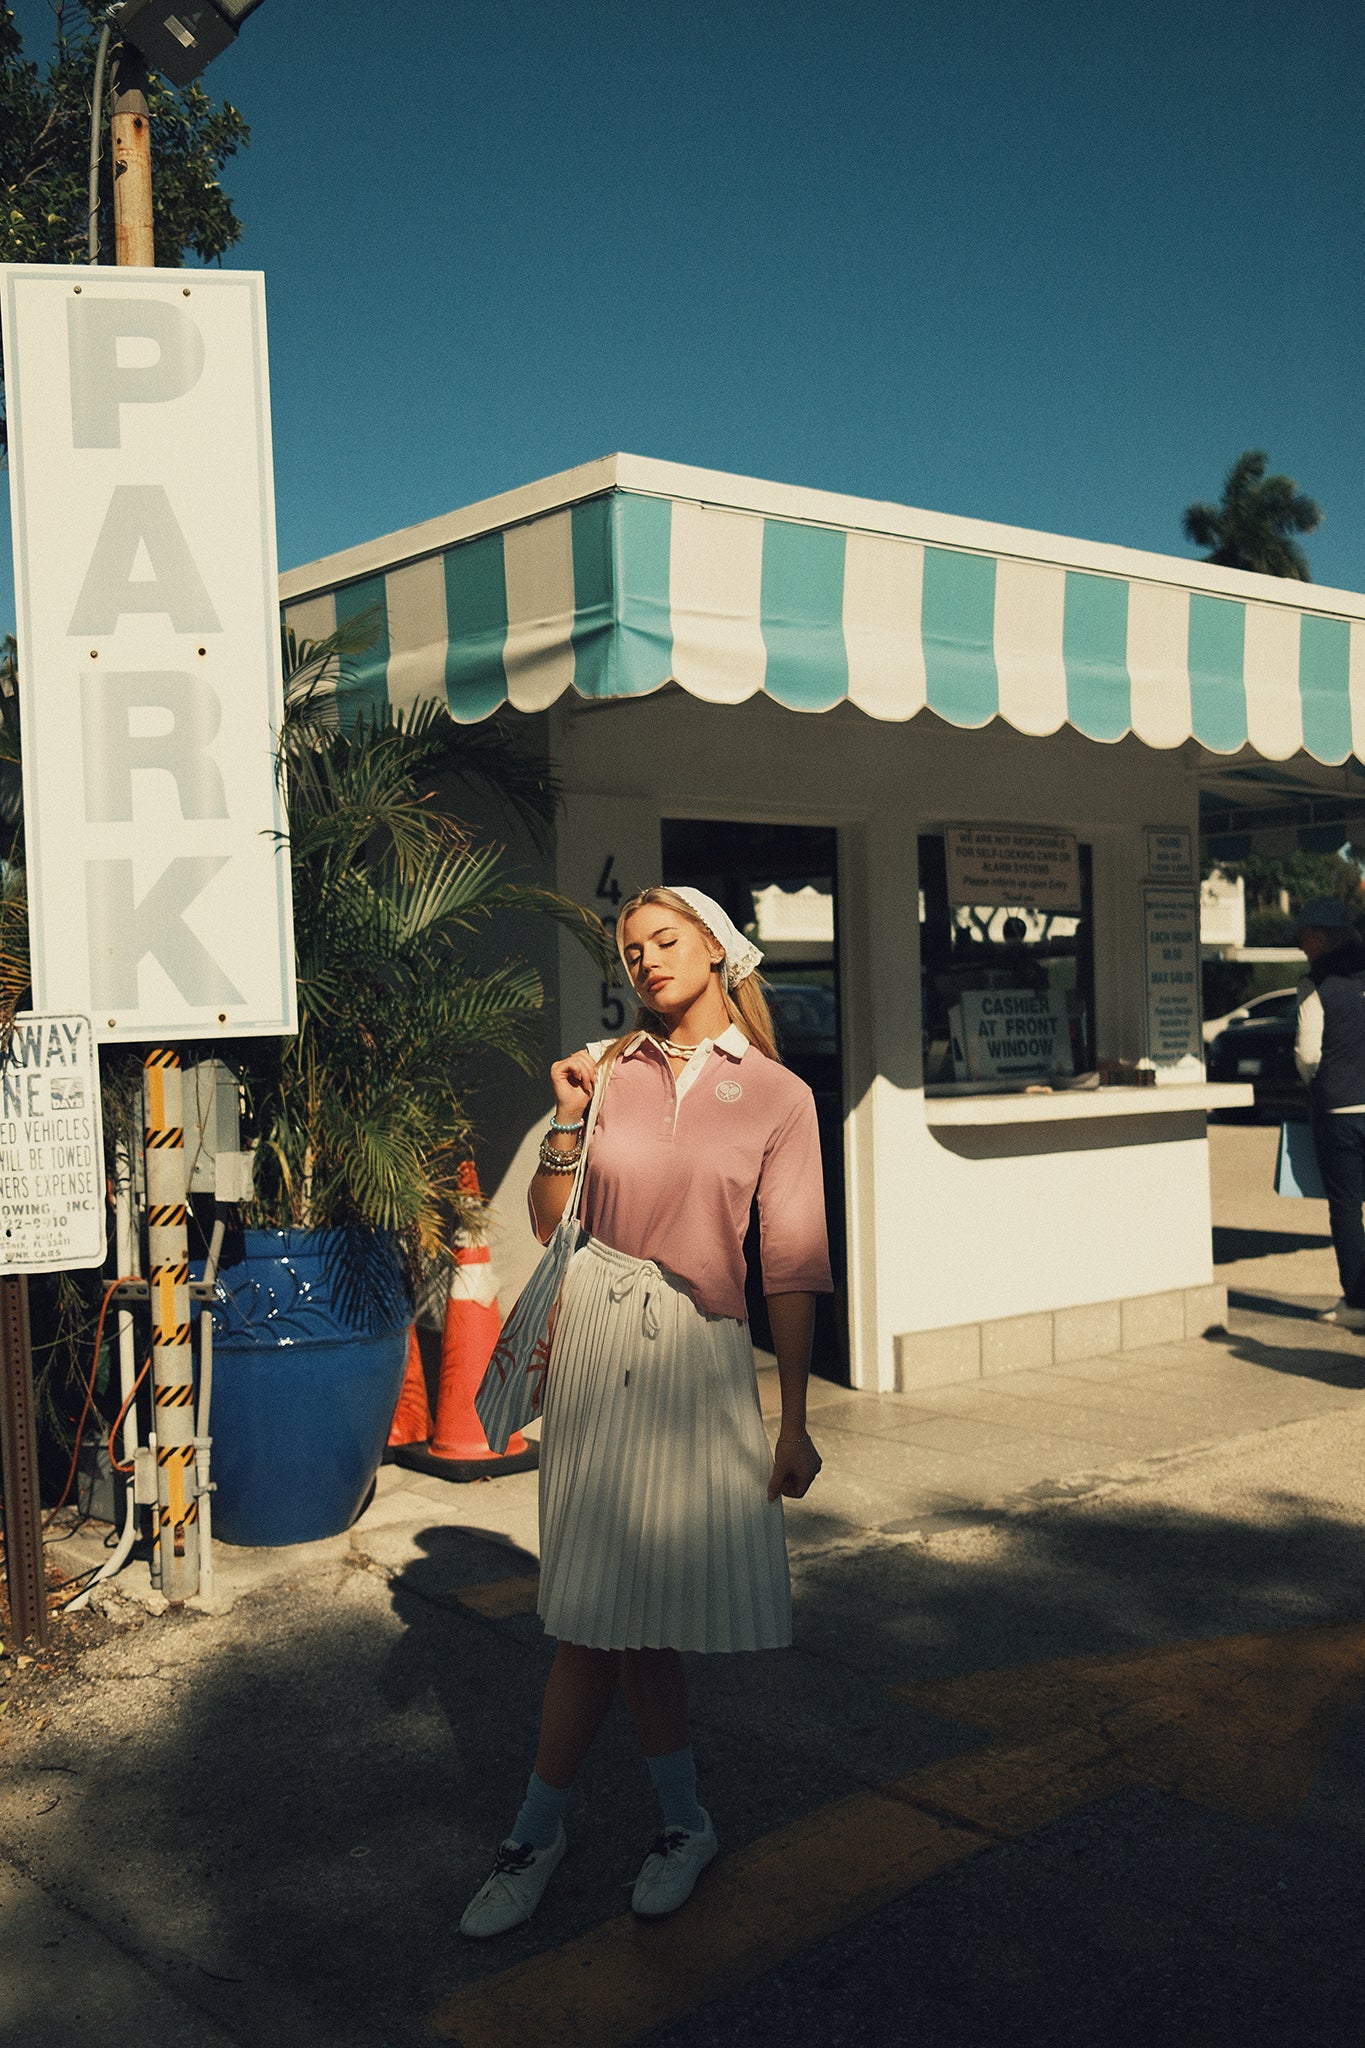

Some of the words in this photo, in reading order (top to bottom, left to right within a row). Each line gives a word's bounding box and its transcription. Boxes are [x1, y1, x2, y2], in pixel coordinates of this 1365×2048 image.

[66, 297, 247, 1011] PARK
[982, 996, 1050, 1015] CASHIER
[978, 1019, 996, 1037] AT
[1006, 1017, 1058, 1036] FRONT
[10, 1022, 82, 1067] WAY
[987, 1038, 1054, 1058] WINDOW
[24, 1117, 90, 1143] VEHICLES
[29, 1147, 44, 1170] BE
[50, 1144, 92, 1168] TOWED
[35, 1171, 93, 1198] EXPENSE
[65, 1199, 95, 1213] INC.
[34, 1248, 62, 1259] CARS
